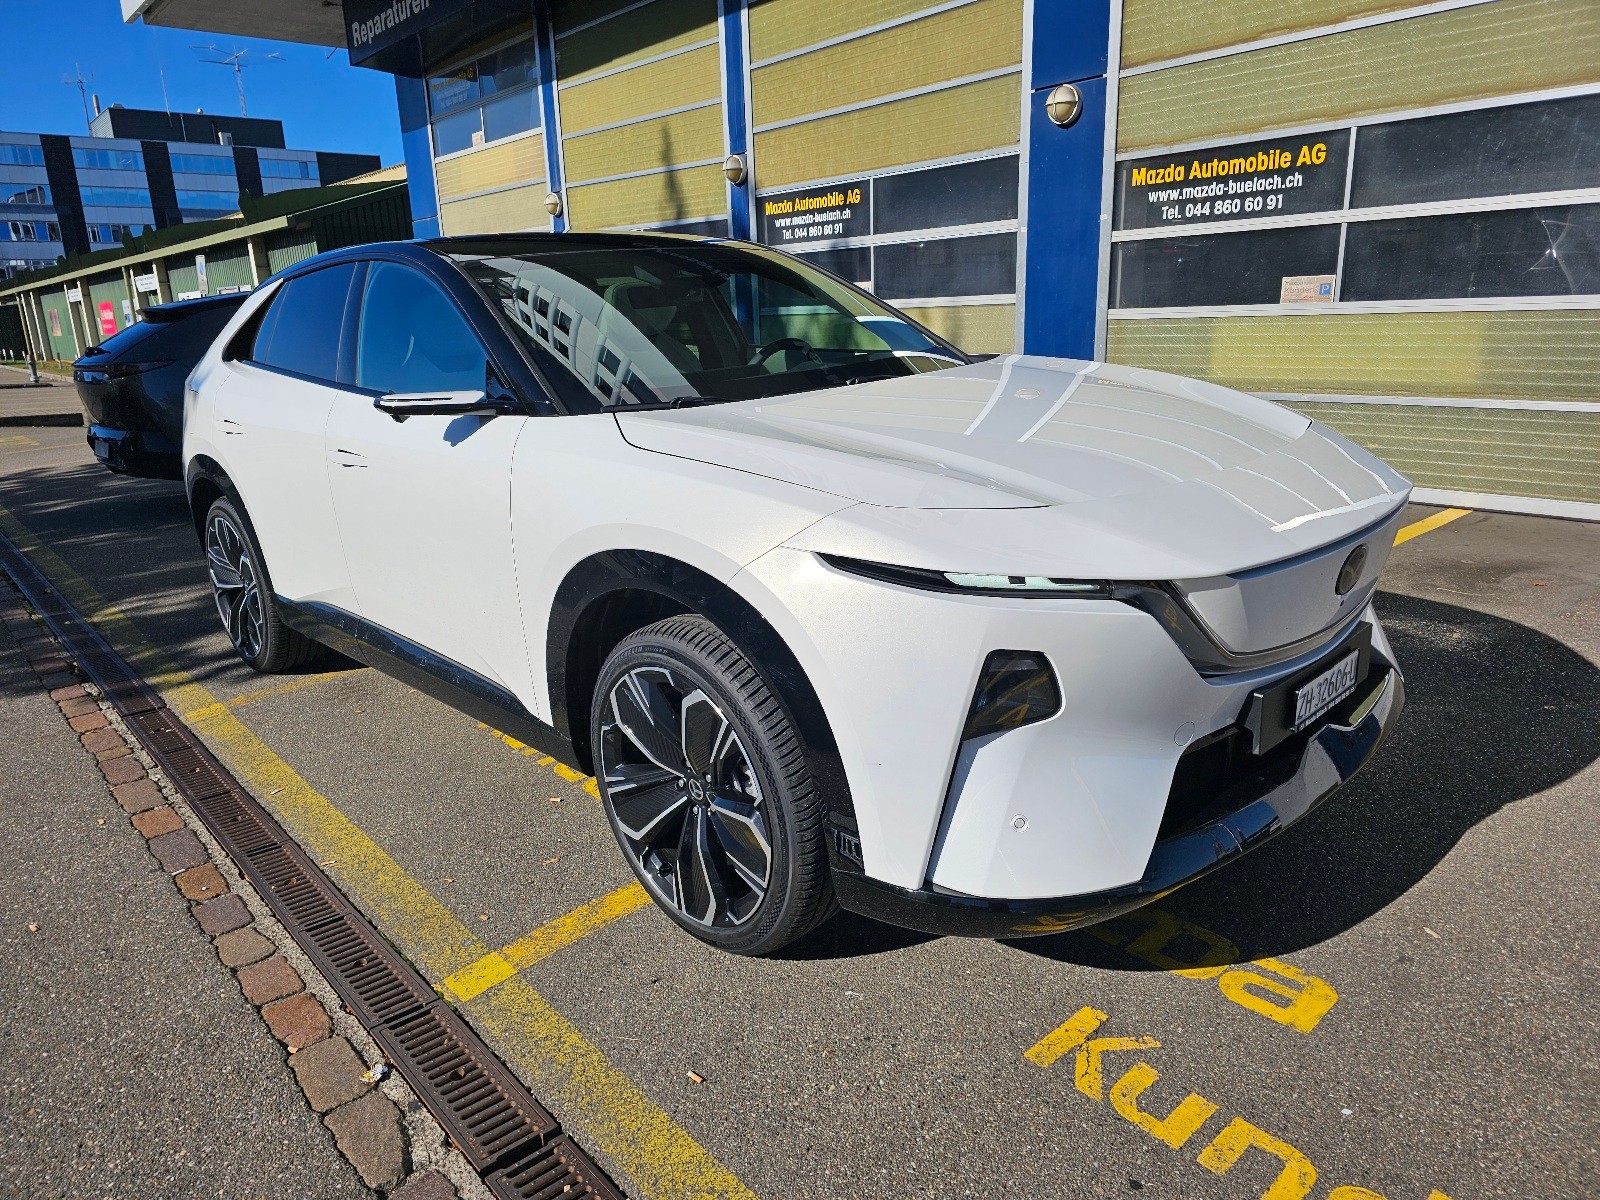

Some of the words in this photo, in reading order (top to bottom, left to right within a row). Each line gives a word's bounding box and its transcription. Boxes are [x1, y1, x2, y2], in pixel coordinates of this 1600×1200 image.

[1131, 164, 1185, 187] Mazda
[1189, 149, 1292, 179] Automobile
[1296, 143, 1327, 167] AG
[1148, 172, 1303, 203] www.mazda-buelach.ch
[765, 200, 793, 216] Mazda
[794, 191, 845, 212] Automobile
[846, 188, 861, 205] AG
[1161, 205, 1181, 220] Tel.
[1185, 201, 1210, 218] 044
[1214, 198, 1241, 215] 860
[1244, 196, 1263, 212] 60
[1267, 193, 1284, 210] 91
[774, 208, 851, 228] www.mazda-buelach.ch
[782, 229, 793, 240] Tel.
[795, 227, 808, 239] 044
[808, 225, 822, 237] 860
[823, 224, 833, 236] 60
[834, 222, 843, 235] 91
[1023, 1005, 1453, 1200] Kun
